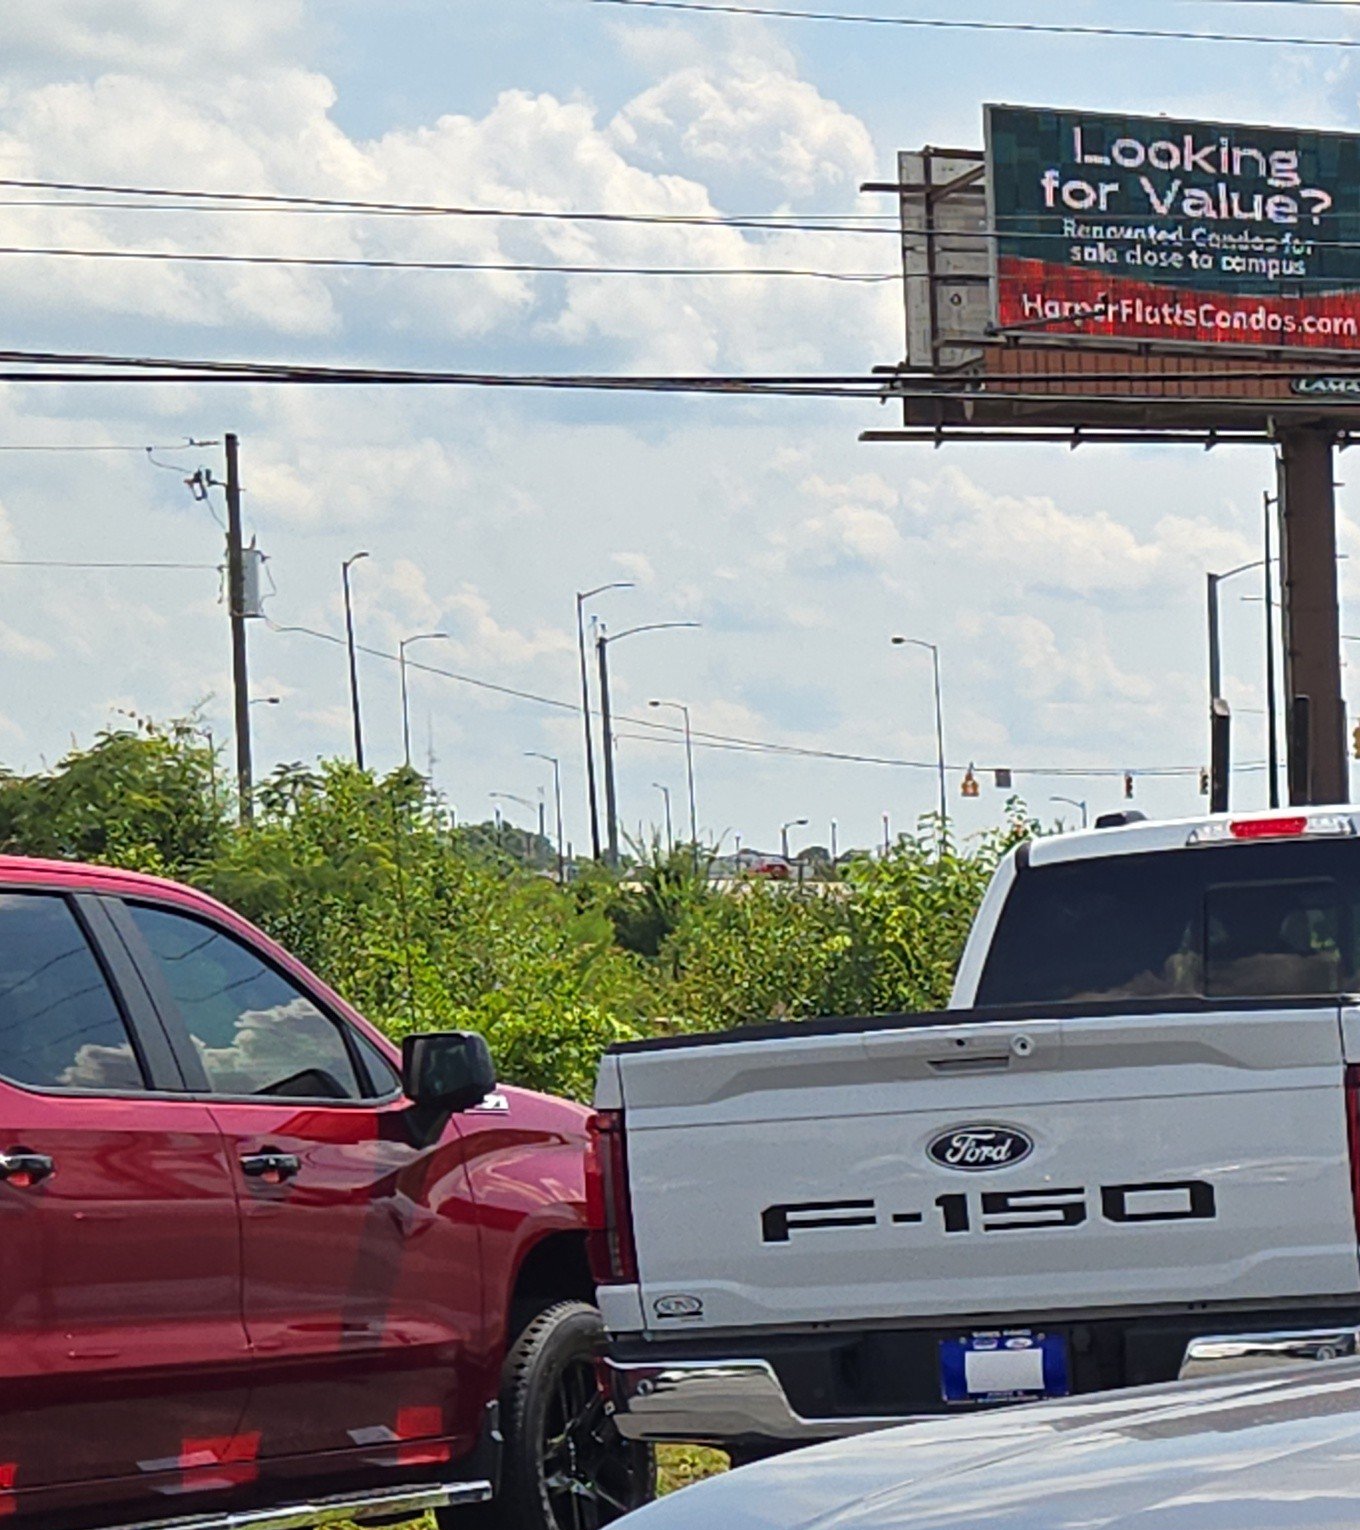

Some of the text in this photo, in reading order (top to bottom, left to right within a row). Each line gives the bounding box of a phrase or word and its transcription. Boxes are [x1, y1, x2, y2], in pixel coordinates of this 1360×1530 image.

[1072, 125, 1302, 188] Looking
[1040, 168, 1333, 226] for Value?
[1125, 243, 1184, 270] close
[1189, 249, 1214, 270] to
[1221, 254, 1307, 281] campus
[945, 1130, 1012, 1164] Ford
[760, 1179, 1217, 1243] F-150
